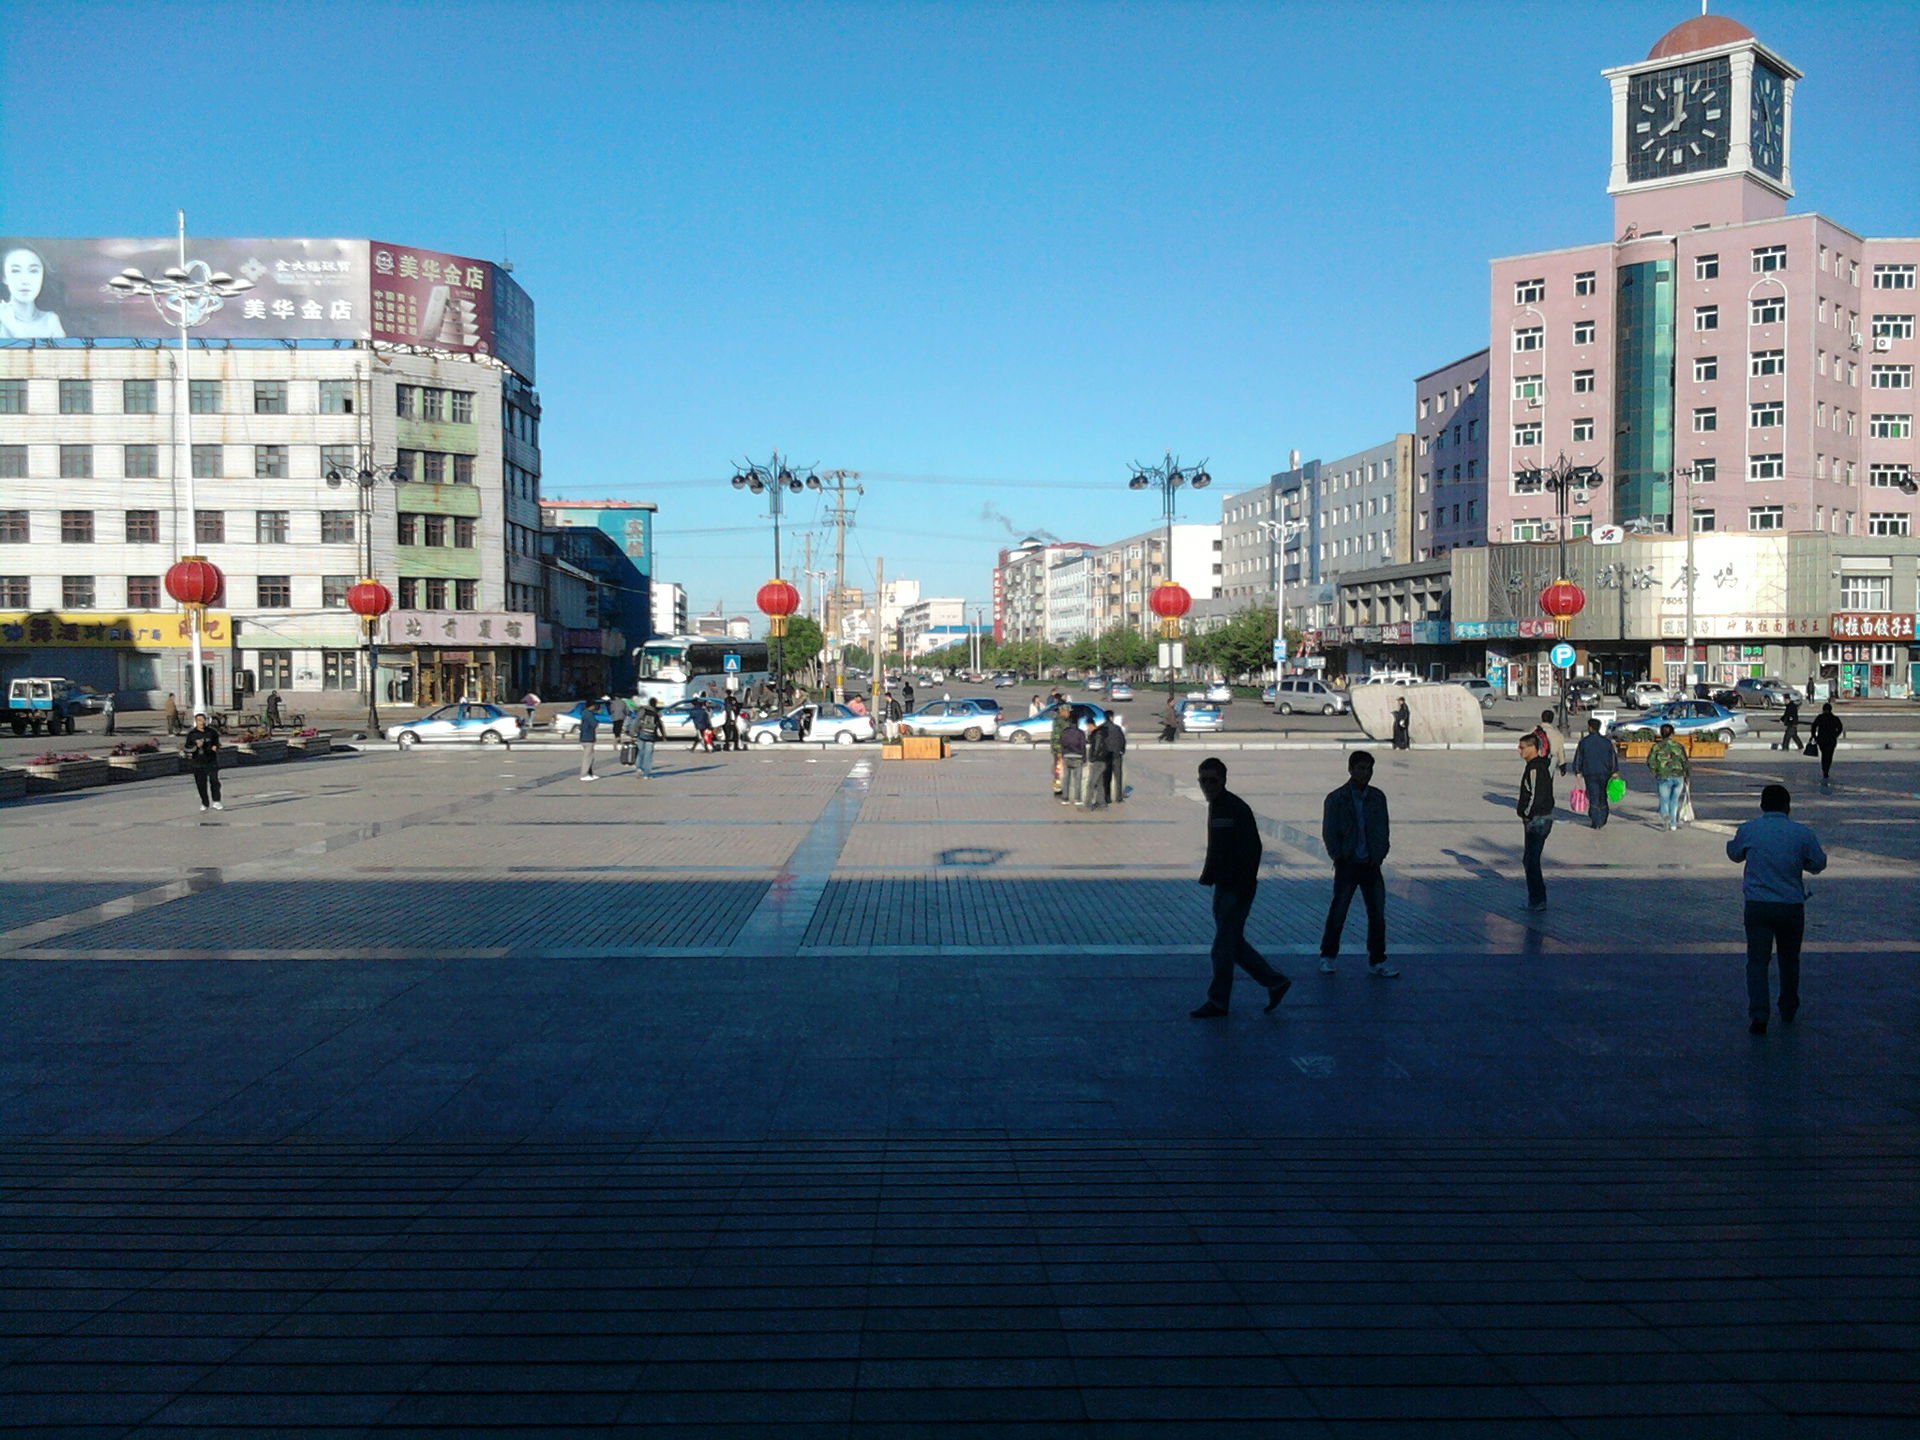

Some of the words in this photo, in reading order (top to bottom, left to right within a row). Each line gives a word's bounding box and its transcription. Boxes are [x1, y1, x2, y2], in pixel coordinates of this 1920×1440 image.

[399, 254, 485, 290] 美华金店
[243, 298, 353, 320] 美华金店
[1557, 647, 1573, 664] P
